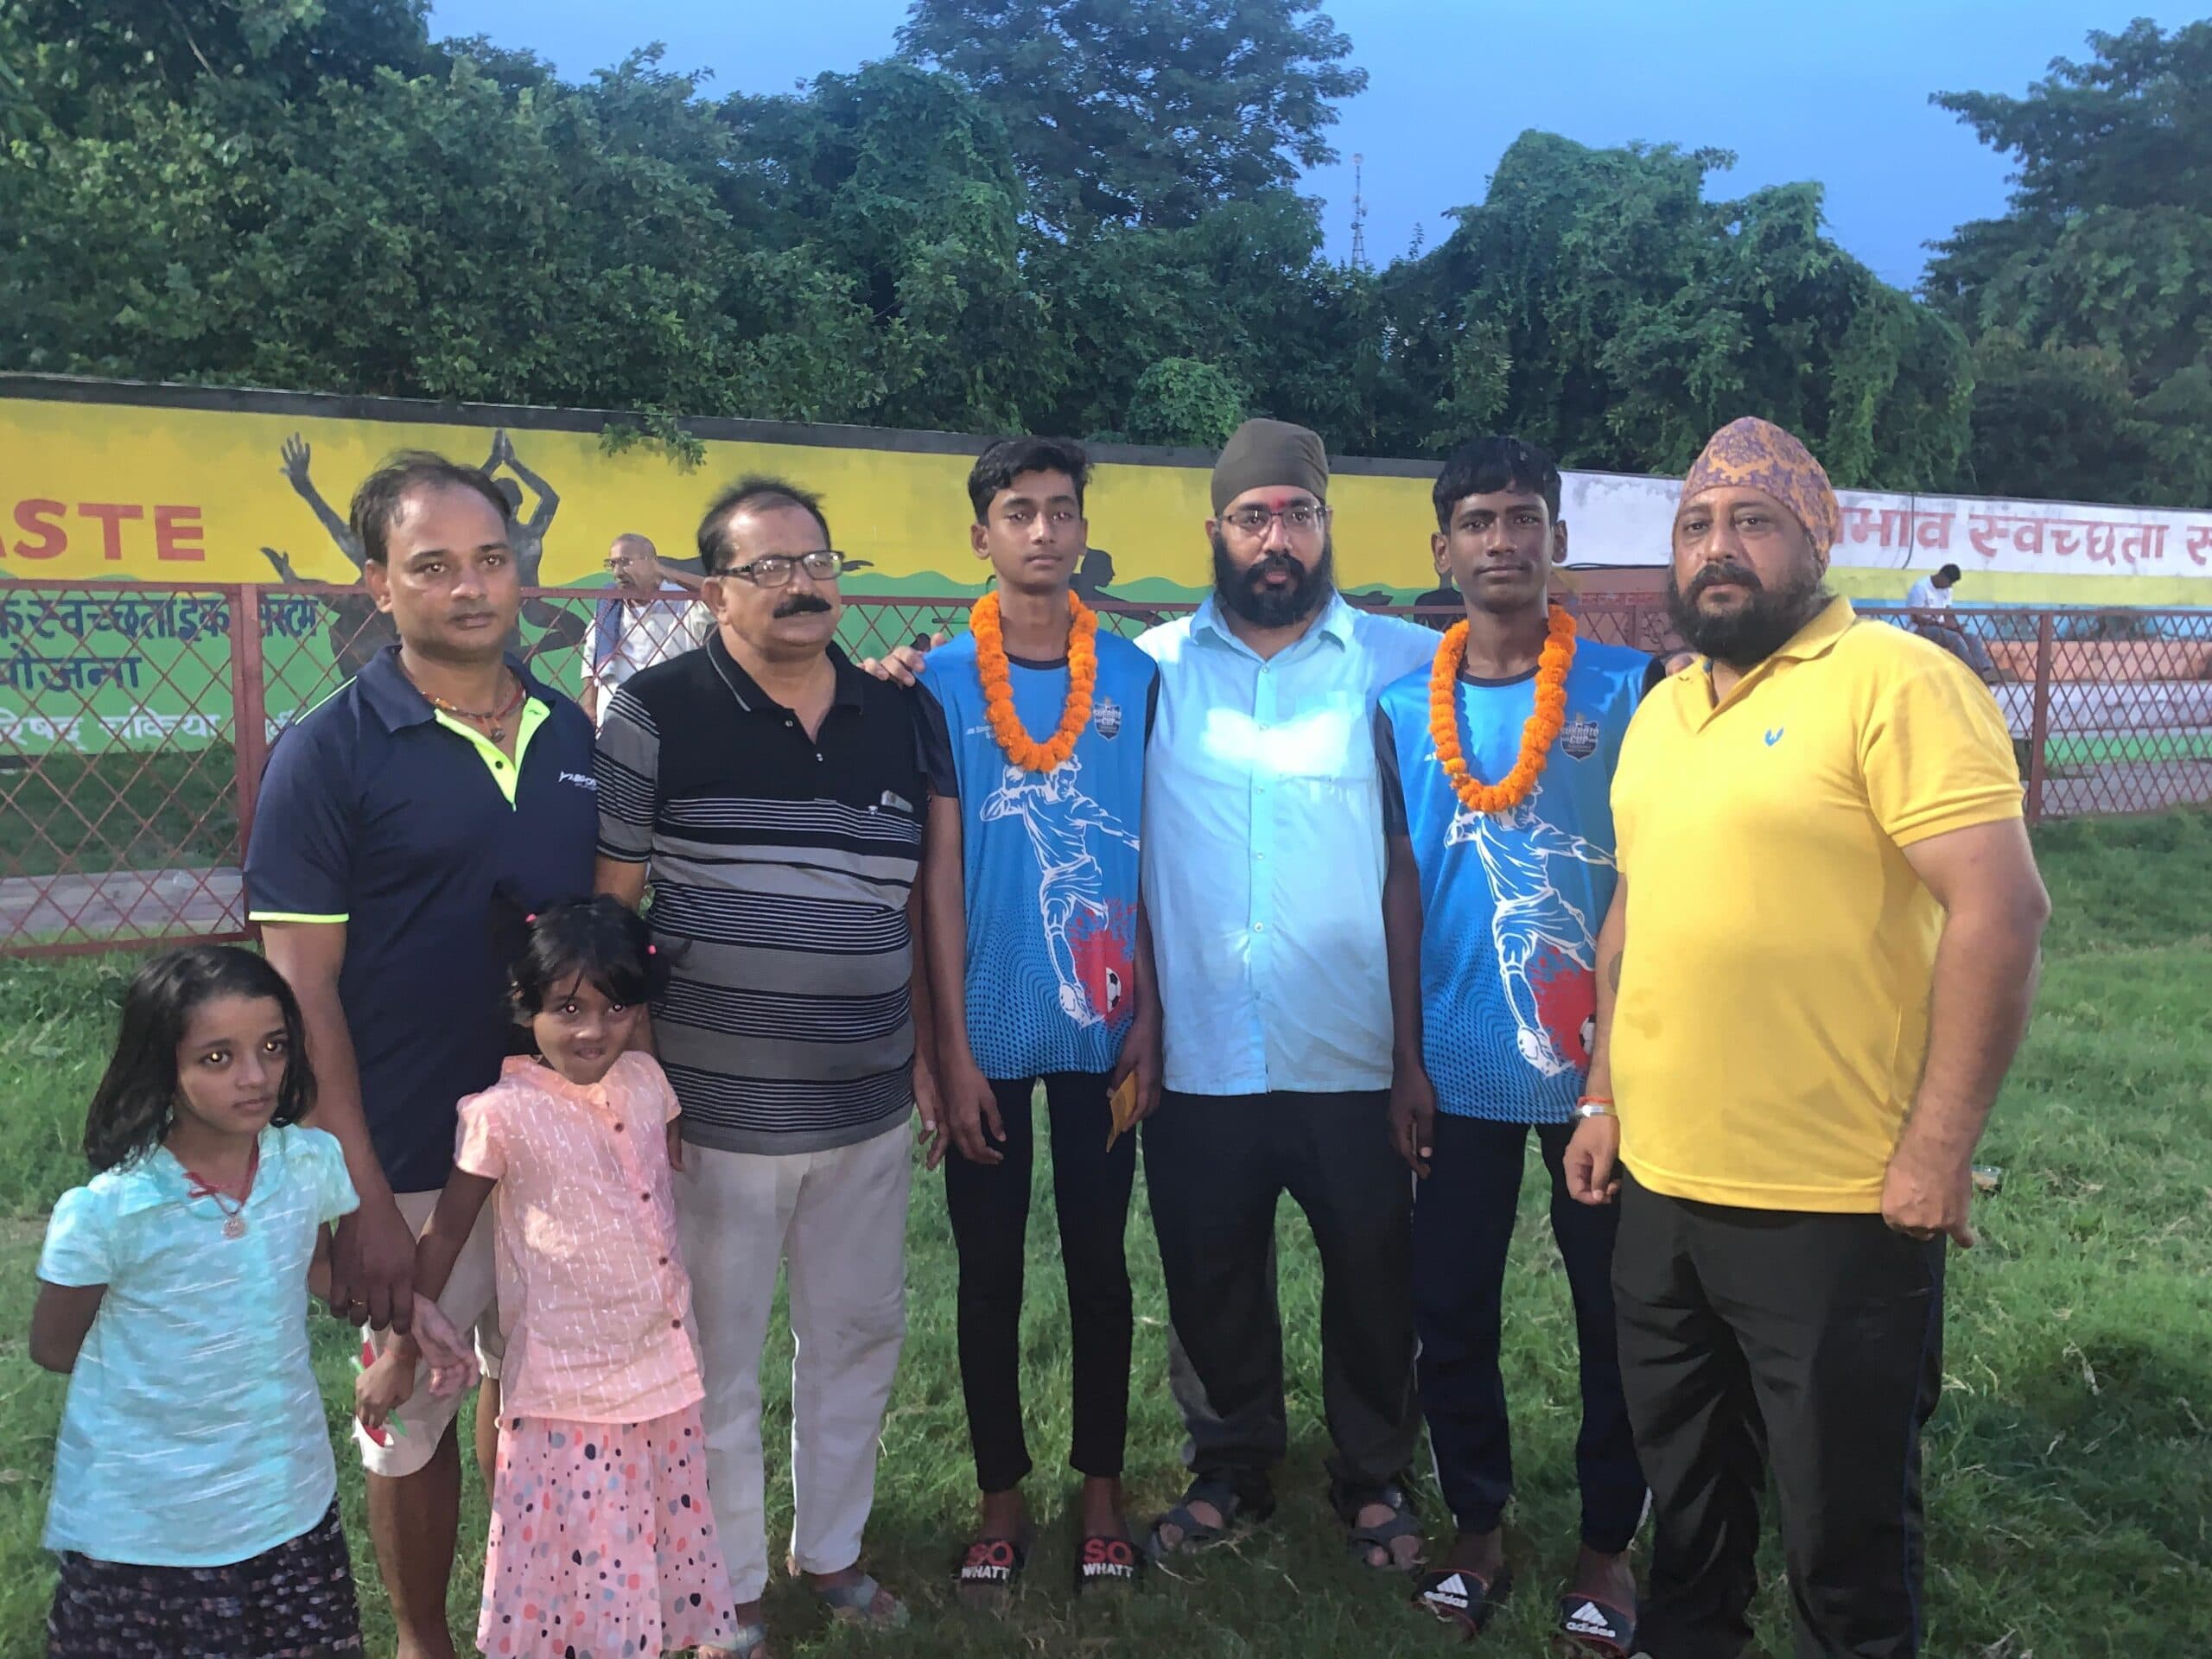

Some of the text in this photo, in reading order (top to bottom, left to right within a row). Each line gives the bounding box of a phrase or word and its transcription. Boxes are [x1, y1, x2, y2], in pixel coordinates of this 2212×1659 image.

[0, 499, 205, 562] STE
[1968, 513, 2171, 567] स्वच्छता
[1084, 1538, 1134, 1563] SO
